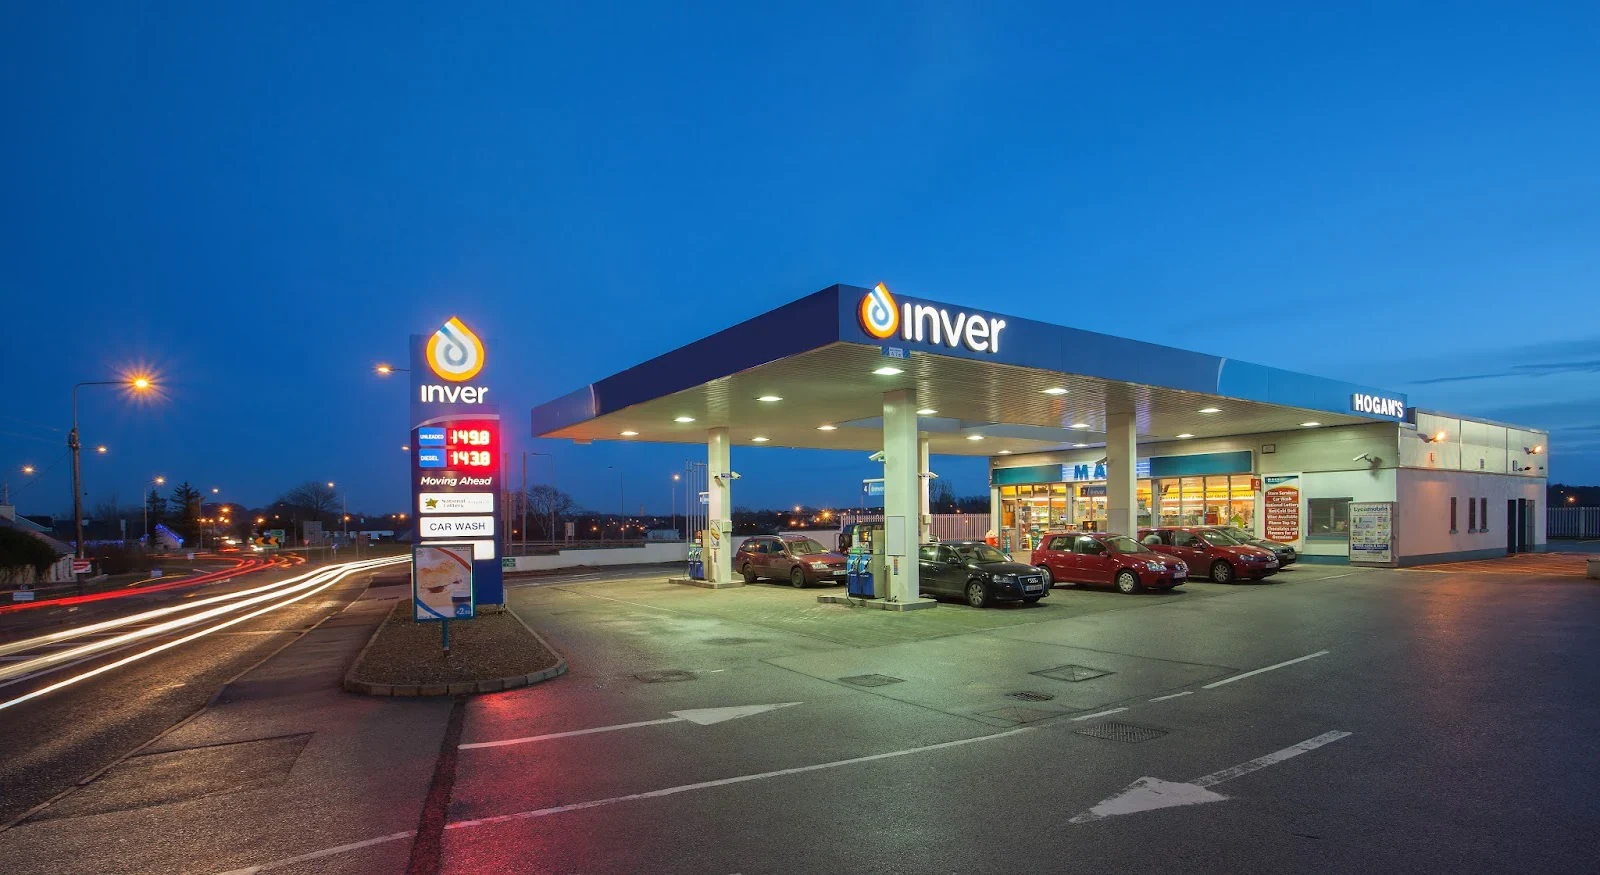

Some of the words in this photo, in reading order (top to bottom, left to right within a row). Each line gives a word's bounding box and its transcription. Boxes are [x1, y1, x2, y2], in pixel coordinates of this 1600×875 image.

[902, 302, 1006, 353] inver
[421, 384, 488, 404] inver
[1355, 393, 1404, 418] HOGAN'S
[420, 476, 457, 487] Moving
[459, 476, 492, 485] Ahead
[429, 522, 452, 531] CAR
[454, 522, 486, 531] WASH
